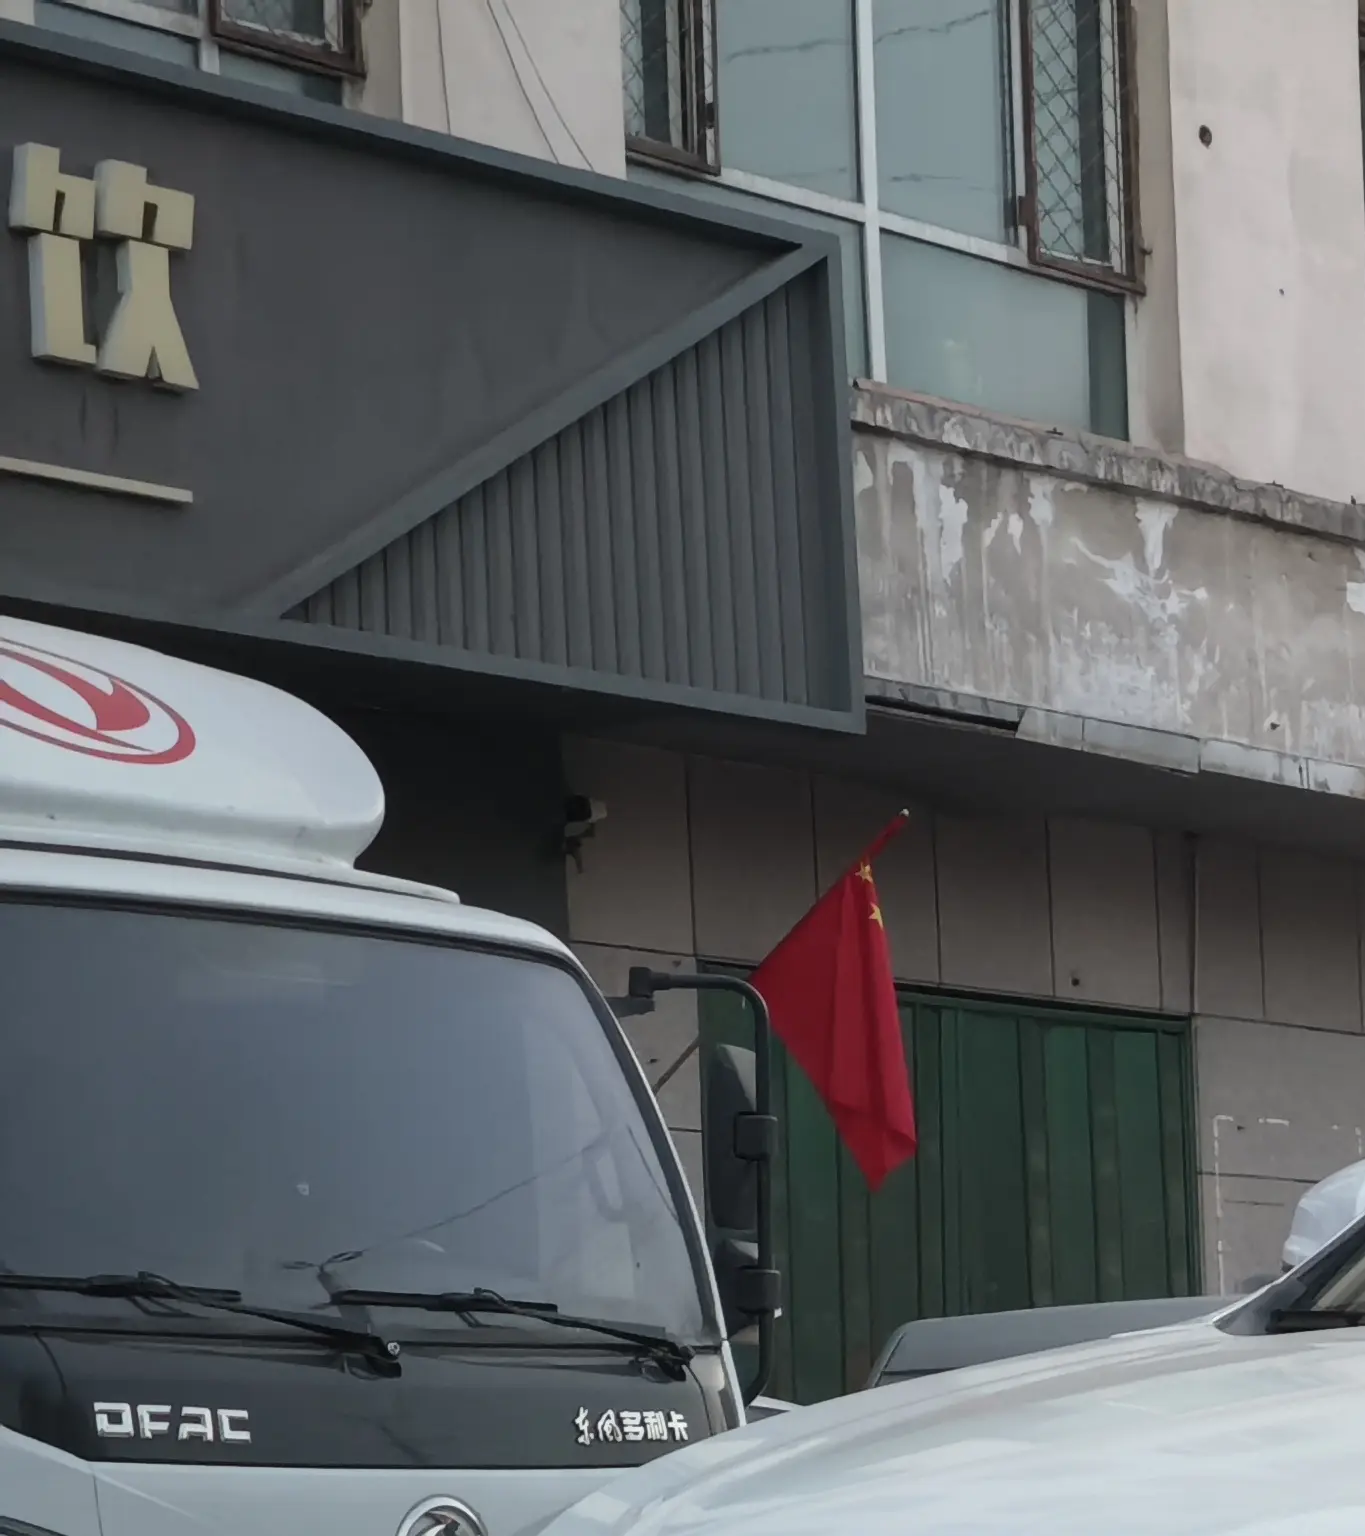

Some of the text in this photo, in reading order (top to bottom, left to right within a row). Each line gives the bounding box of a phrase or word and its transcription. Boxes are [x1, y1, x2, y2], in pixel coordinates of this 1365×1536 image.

[94, 1402, 252, 1443] DFAC
[575, 1406, 688, 1445] 东风多利卡
